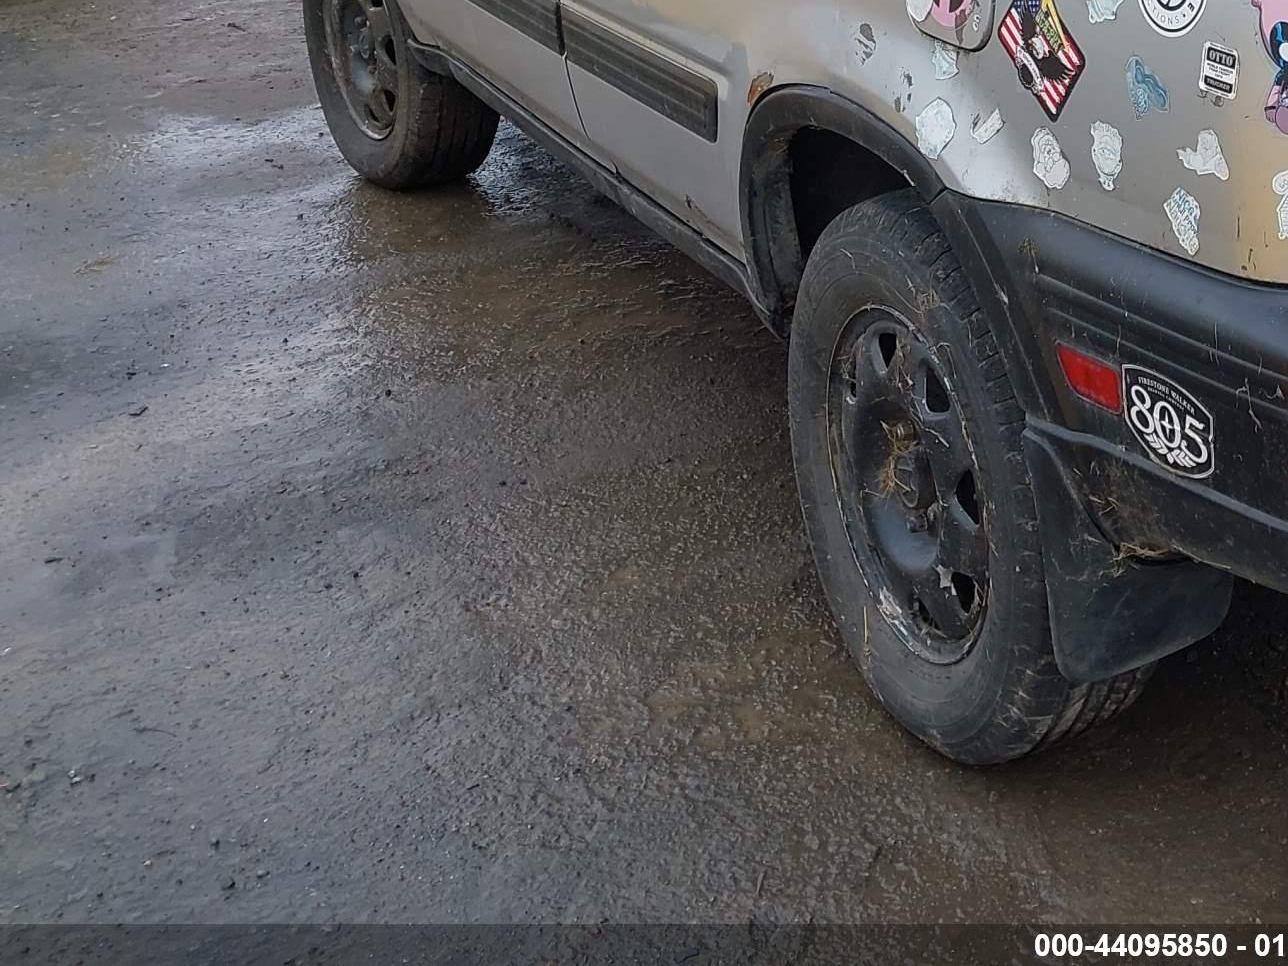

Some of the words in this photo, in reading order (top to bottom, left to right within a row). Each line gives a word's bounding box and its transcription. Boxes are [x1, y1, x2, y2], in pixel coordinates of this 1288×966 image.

[1209, 49, 1234, 67] OTTO
[1138, 376, 1170, 396] FIRESTONE
[1170, 390, 1196, 415] WALKER
[1130, 384, 1209, 464] 805
